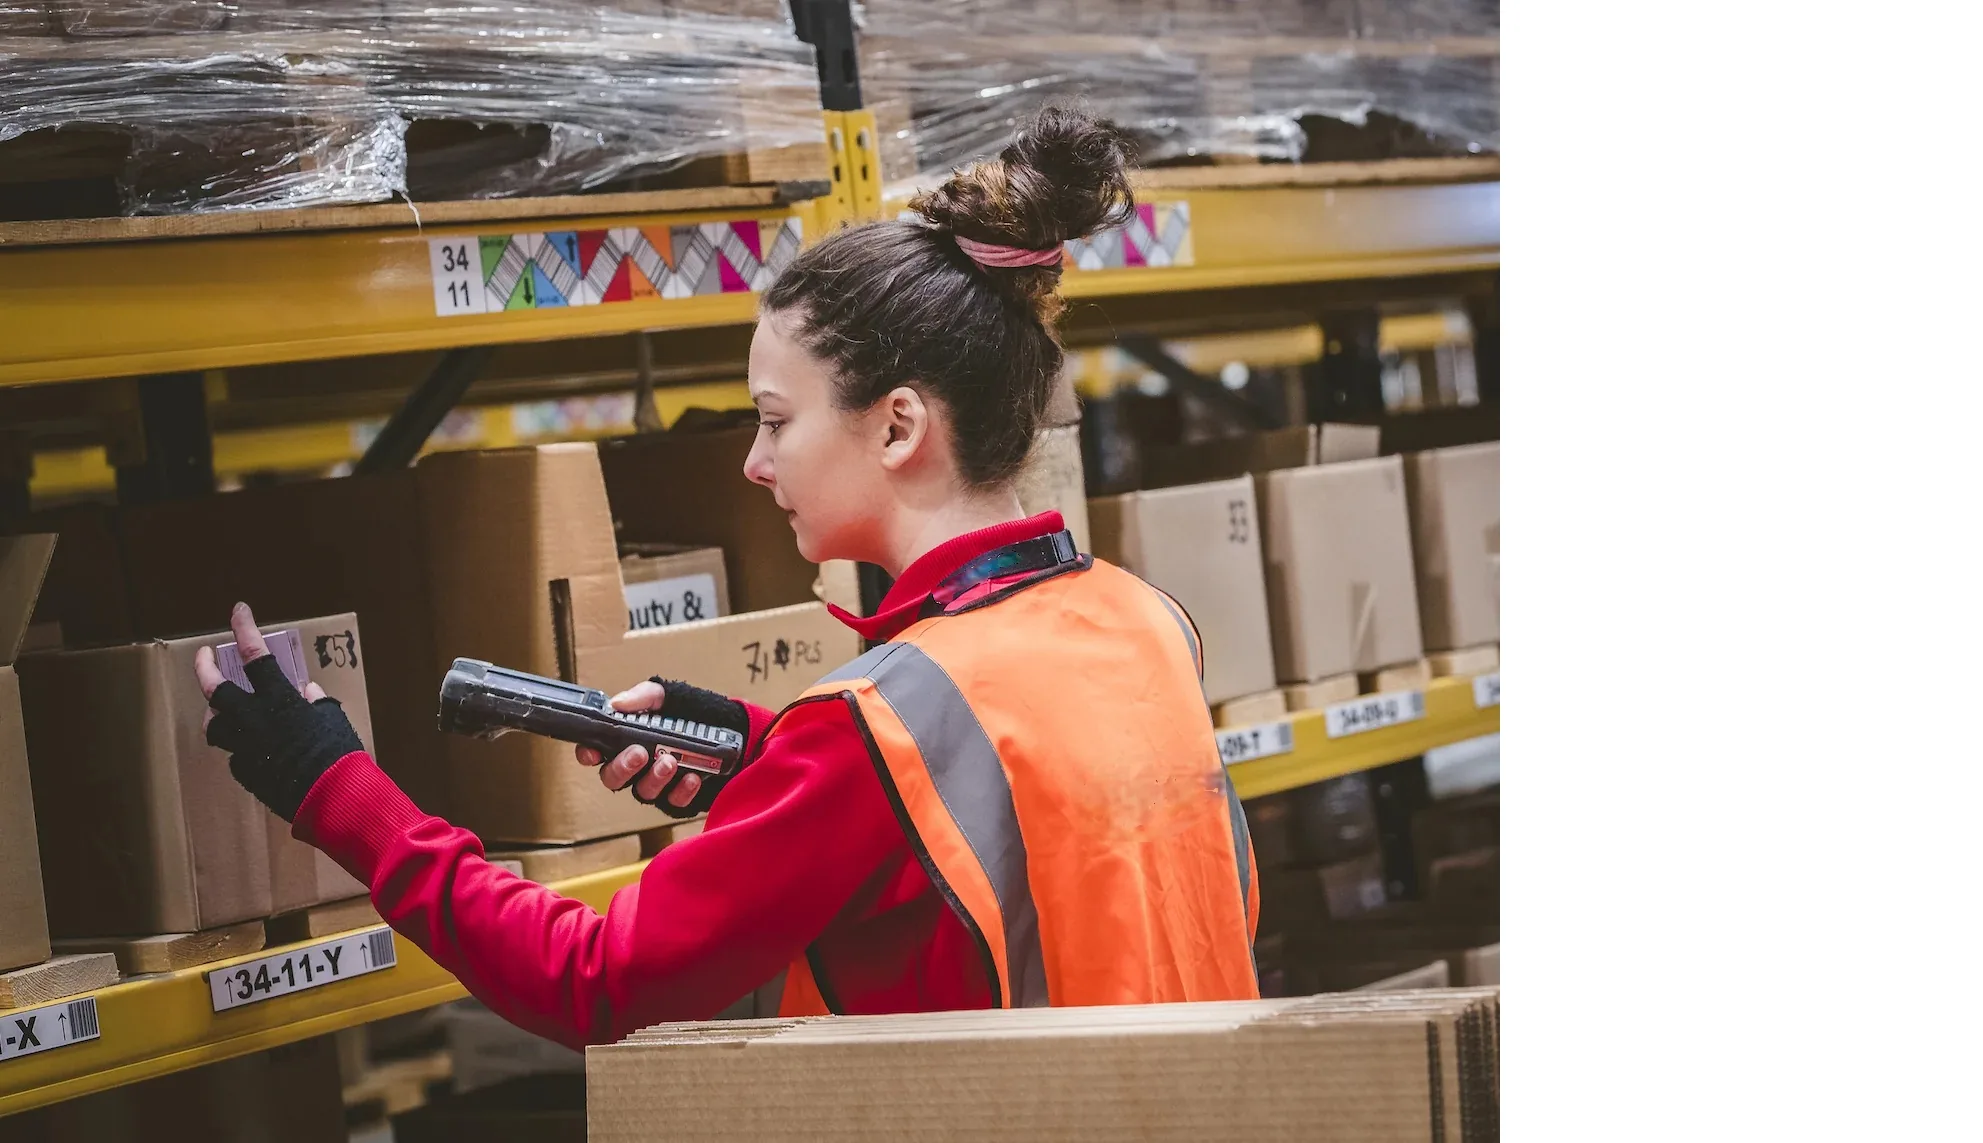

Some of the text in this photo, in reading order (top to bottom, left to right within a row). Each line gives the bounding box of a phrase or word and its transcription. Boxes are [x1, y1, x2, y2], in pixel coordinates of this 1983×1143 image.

[442, 244, 469, 272] 34
[448, 280, 470, 307] 11
[683, 590, 704, 621] &
[235, 945, 343, 1000] 34-11-Y
[0, 1015, 41, 1055] -X
